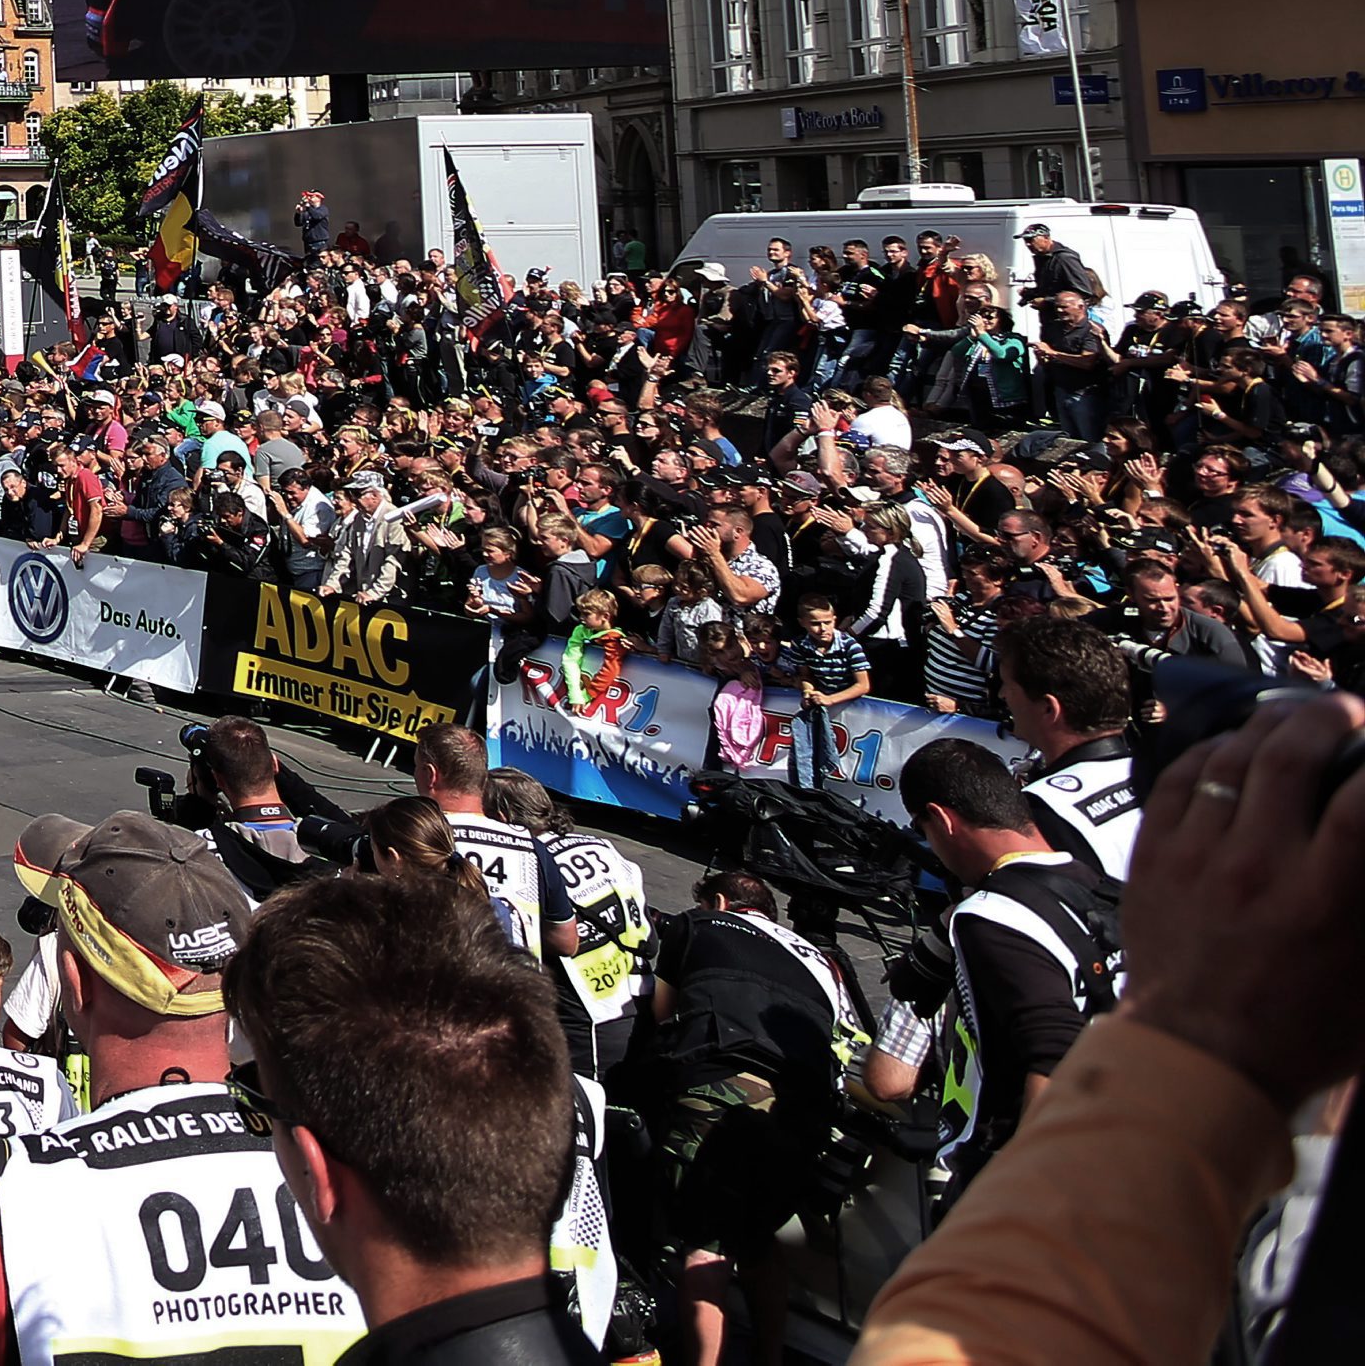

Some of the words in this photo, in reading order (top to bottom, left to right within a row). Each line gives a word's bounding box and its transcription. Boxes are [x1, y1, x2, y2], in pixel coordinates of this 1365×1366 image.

[1208, 73, 1337, 99] Villeroy
[850, 105, 881, 125] Boch
[100, 601, 131, 629] Das
[135, 610, 181, 640] Auto.
[254, 582, 410, 686] ADAC
[245, 661, 324, 707] immer
[329, 679, 364, 718] für
[366, 693, 401, 730] Sie
[260, 806, 281, 816] EOS
[91, 1113, 202, 1154] RALLYE
[153, 1292, 346, 1325] PHOTOGRAPHER
